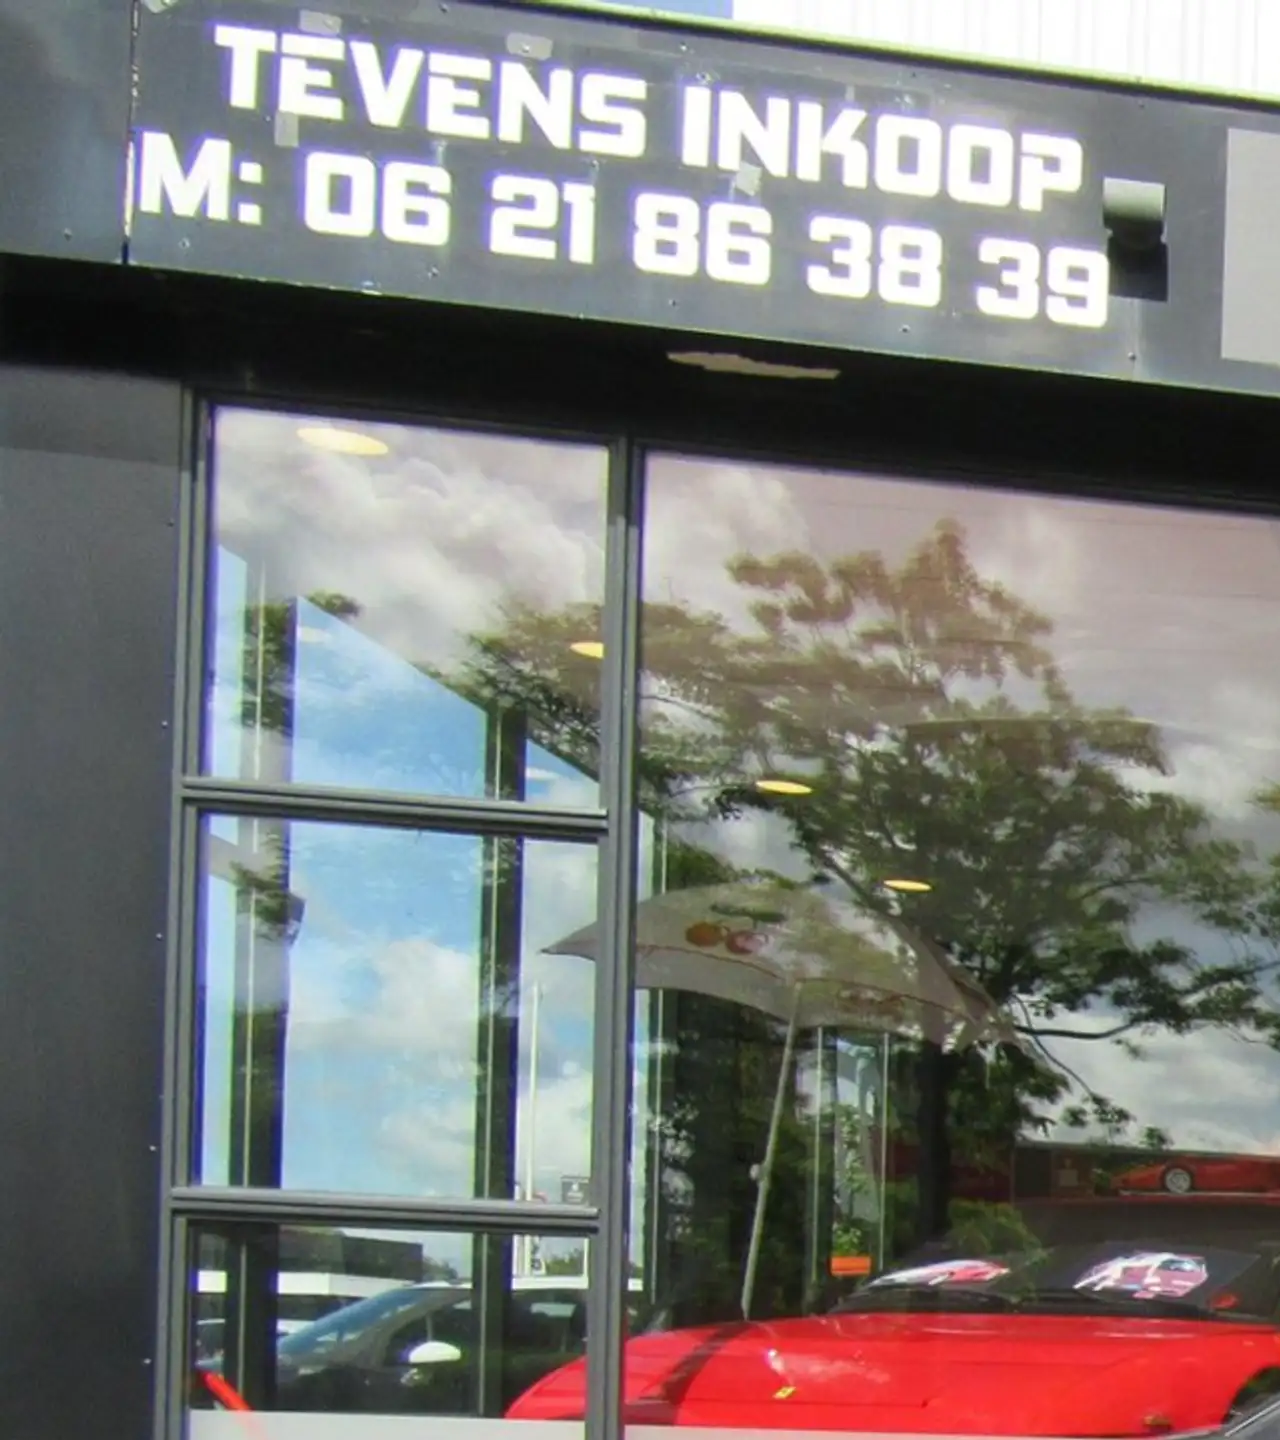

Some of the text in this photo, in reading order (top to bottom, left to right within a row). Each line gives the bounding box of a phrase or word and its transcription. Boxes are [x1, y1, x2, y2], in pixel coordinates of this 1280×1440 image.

[214, 24, 1083, 212] TEVENS INKOOP
[139, 131, 1109, 329] M: 06 21 86 38 39
